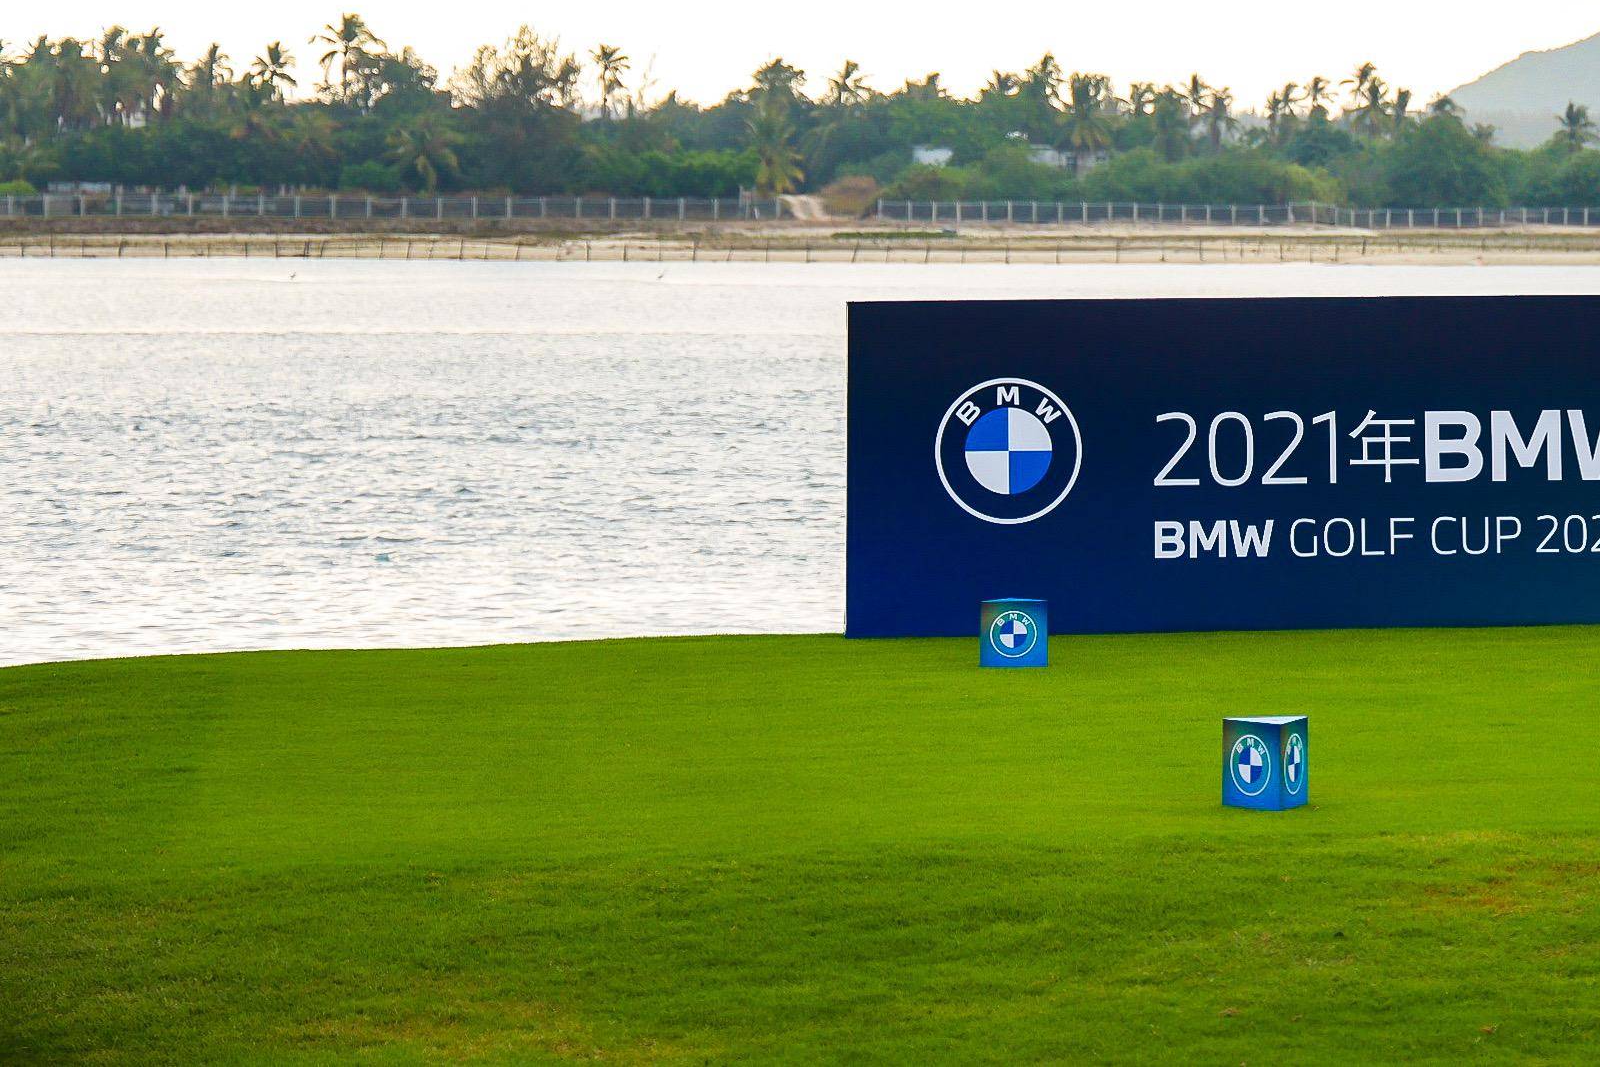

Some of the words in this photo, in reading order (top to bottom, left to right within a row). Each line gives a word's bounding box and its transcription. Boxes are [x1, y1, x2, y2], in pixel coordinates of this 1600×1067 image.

[955, 386, 1062, 427] BMW
[1154, 520, 1274, 559] BMW
[1290, 517, 1415, 557] GOLF
[1430, 515, 1522, 555] CUP
